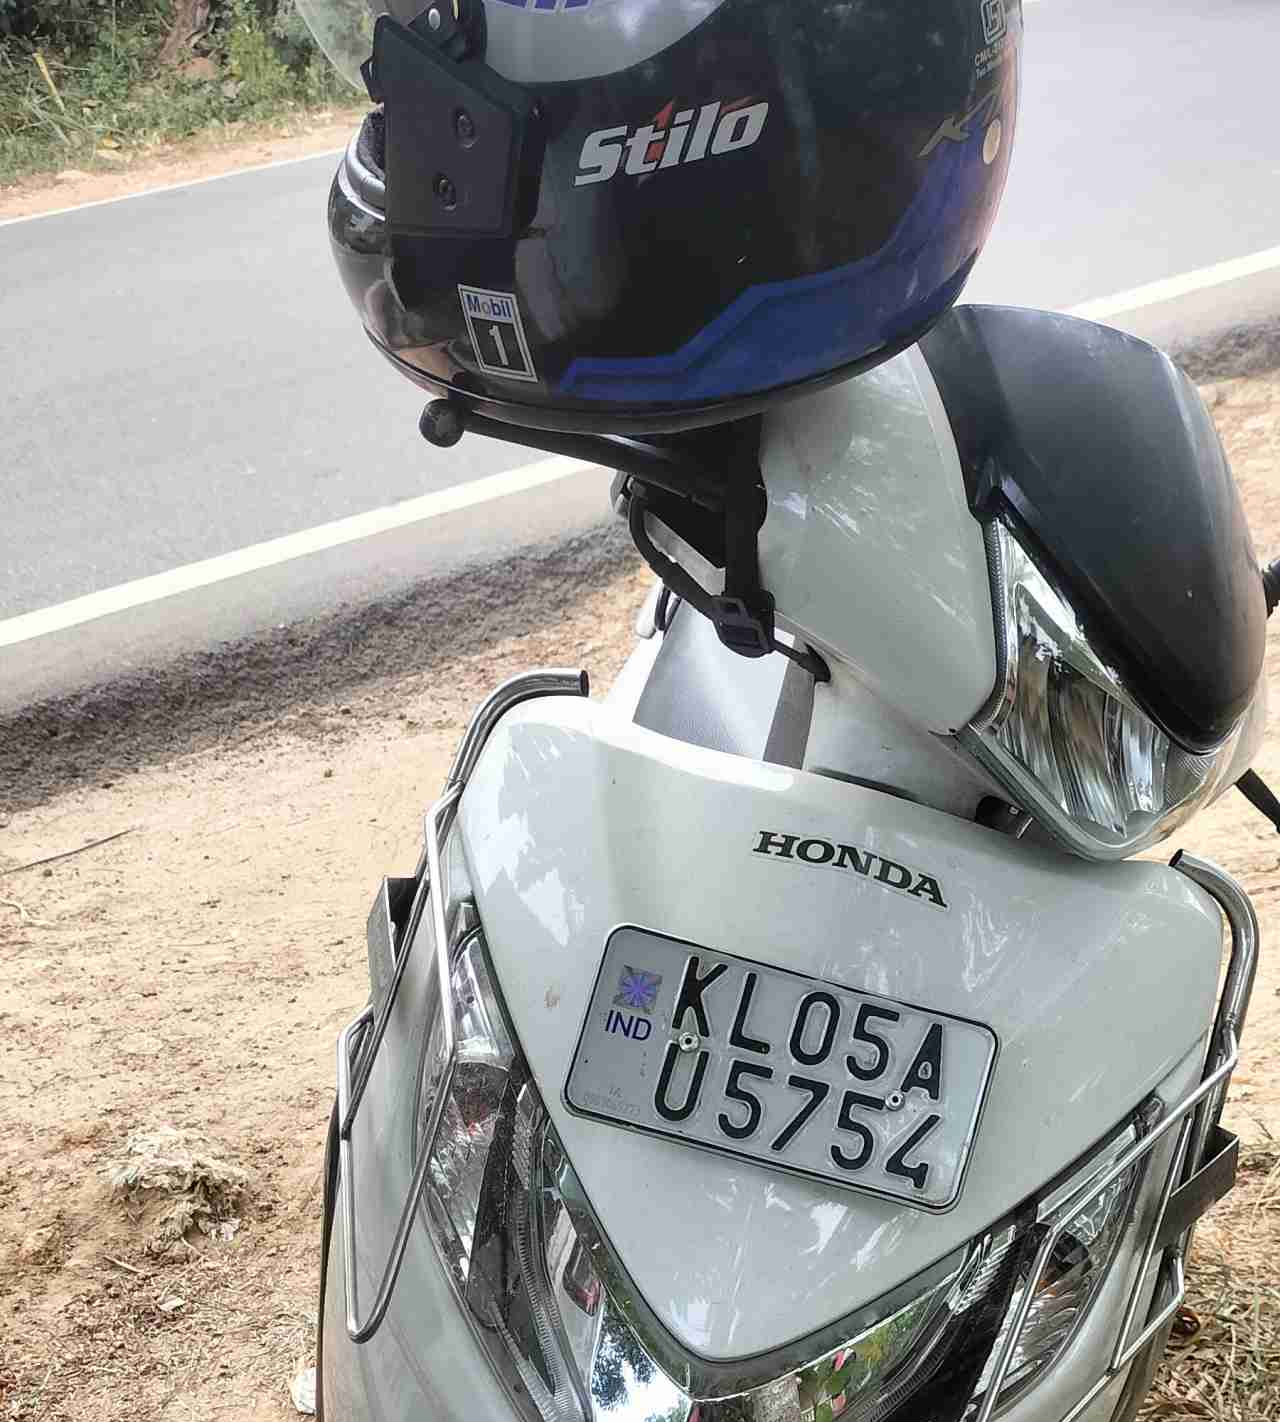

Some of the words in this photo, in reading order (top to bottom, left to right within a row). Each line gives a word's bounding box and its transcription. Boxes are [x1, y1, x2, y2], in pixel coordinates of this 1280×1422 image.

[573, 101, 770, 187] Stilo
[466, 294, 512, 318] Mobil
[488, 324, 510, 366] 1
[752, 830, 948, 908] HONDA
[604, 1010, 652, 1042] IND
[671, 956, 943, 1101] KL05A
